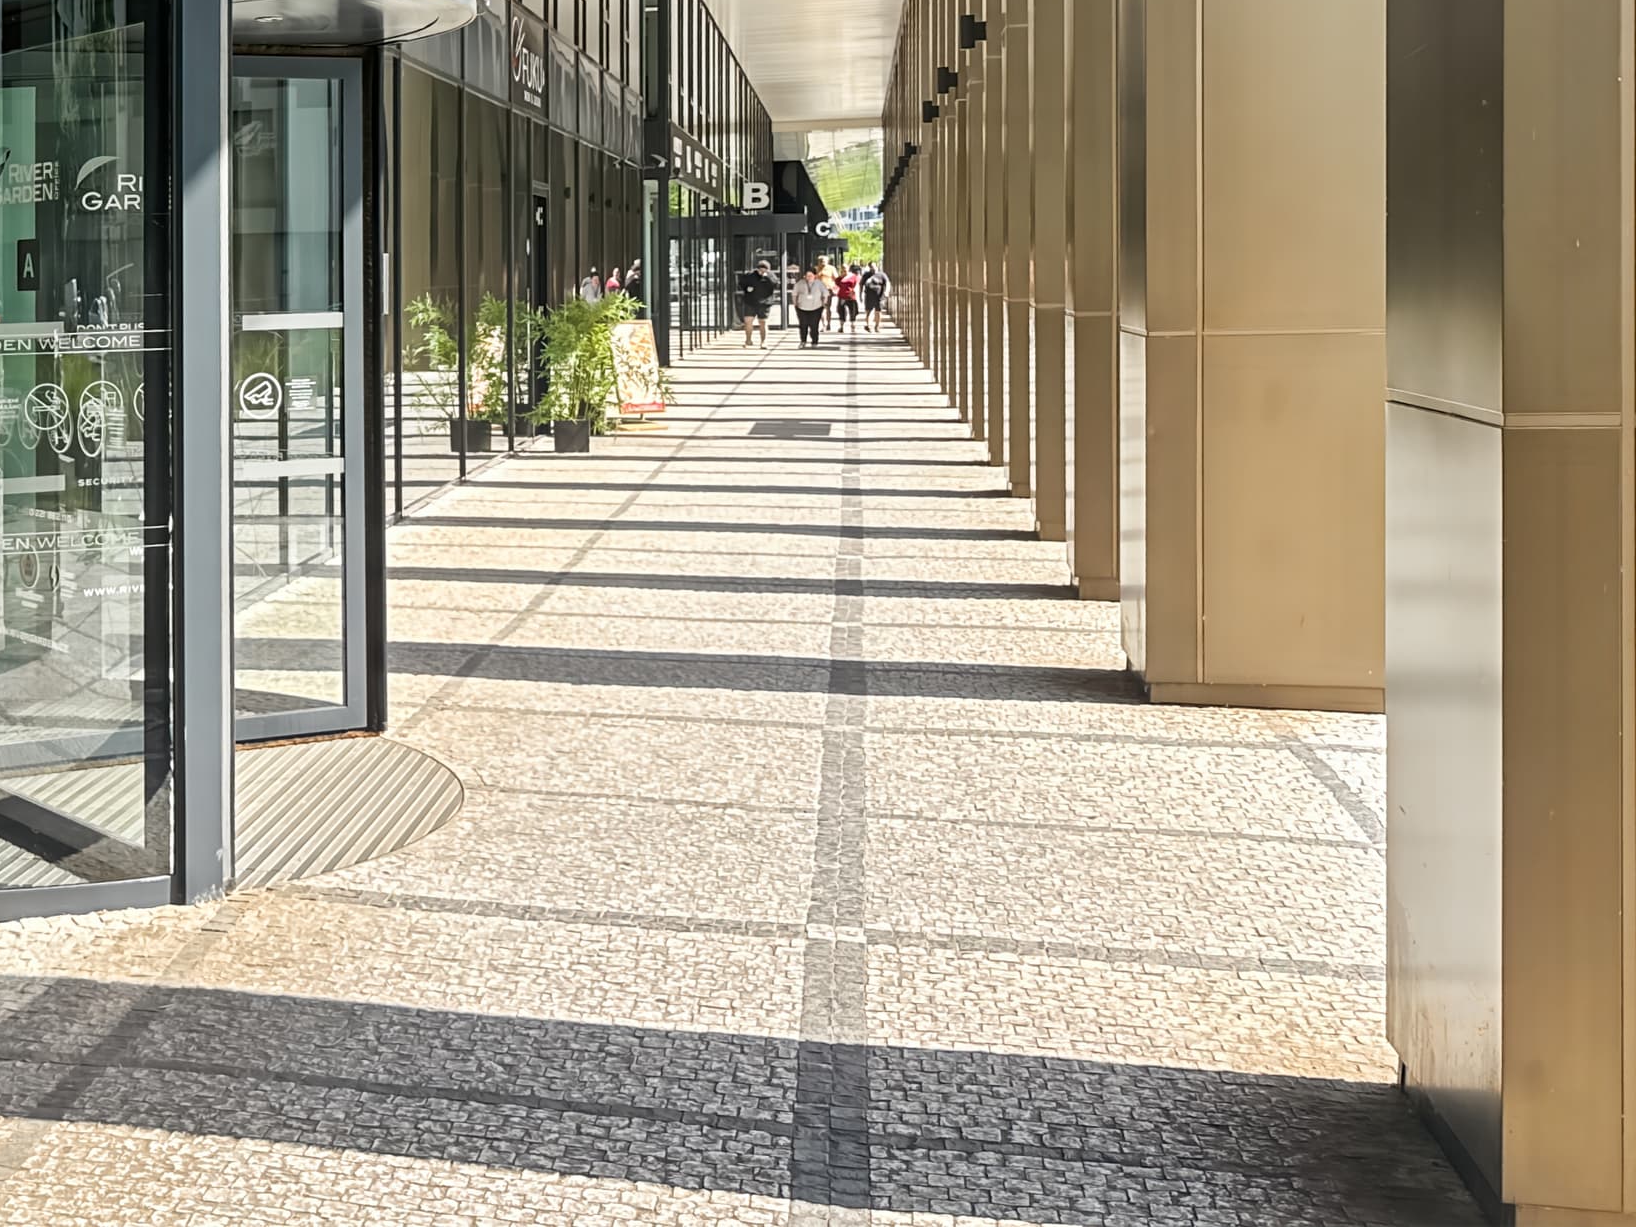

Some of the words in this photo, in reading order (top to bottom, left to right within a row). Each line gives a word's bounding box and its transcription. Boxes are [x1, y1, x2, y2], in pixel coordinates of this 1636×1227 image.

[742, 181, 771, 210] B
[815, 221, 831, 237] C
[22, 252, 35, 279] A
[38, 334, 141, 352] WELCOME
[37, 531, 140, 550] WELCOME
